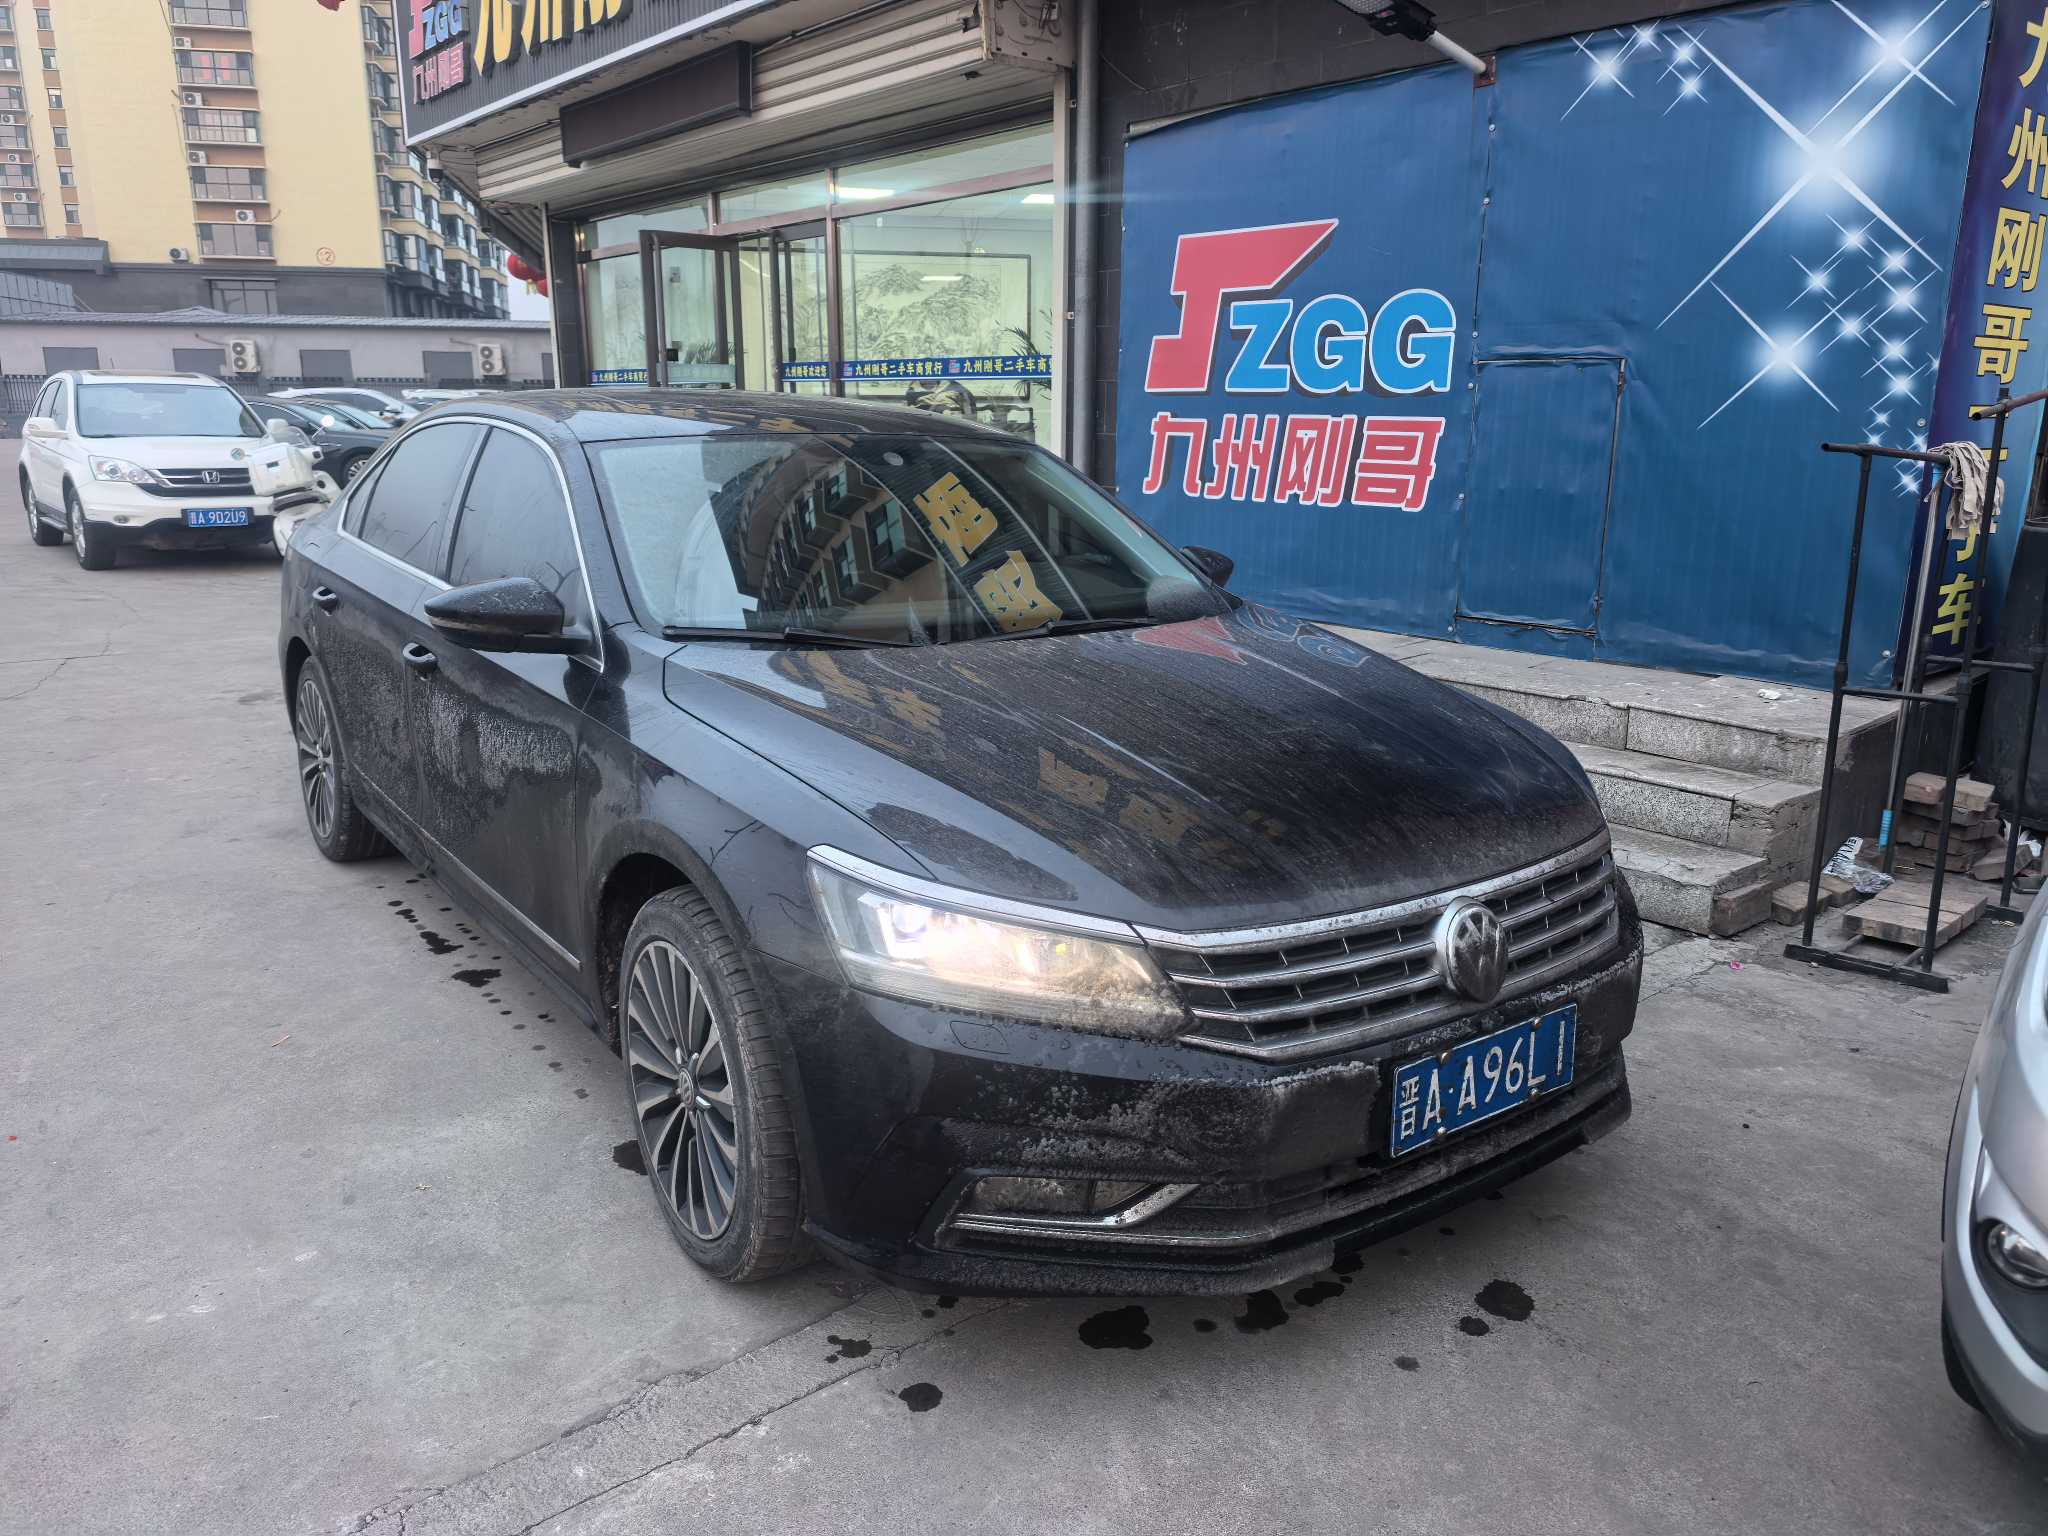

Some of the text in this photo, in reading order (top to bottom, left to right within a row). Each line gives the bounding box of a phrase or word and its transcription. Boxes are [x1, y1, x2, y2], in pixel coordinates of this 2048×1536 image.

[413, 42, 463, 104] 九州刚哥
[963, 357, 1053, 374] 九州刚哥二手车商
[1142, 411, 1446, 512] 九州刚哥
